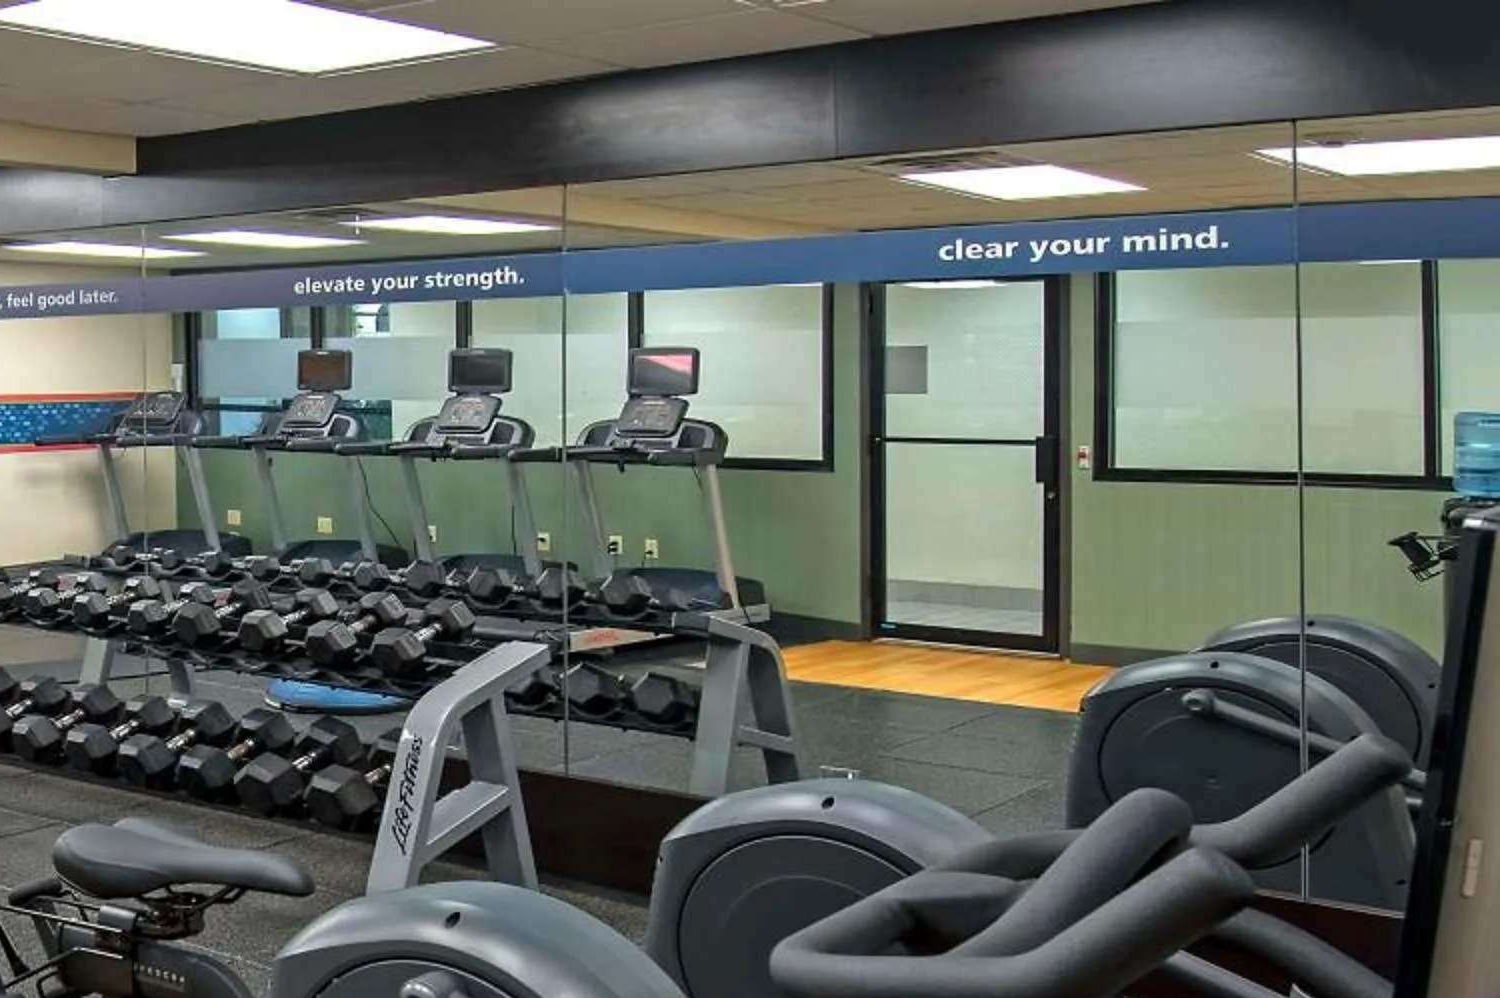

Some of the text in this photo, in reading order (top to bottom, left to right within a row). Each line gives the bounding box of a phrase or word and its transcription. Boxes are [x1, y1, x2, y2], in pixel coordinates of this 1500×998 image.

[938, 225, 1229, 263] clear your mind.
[293, 266, 525, 295] elevate your strength.
[6, 292, 33, 308] feel
[37, 290, 75, 310] good
[79, 289, 118, 304] later.
